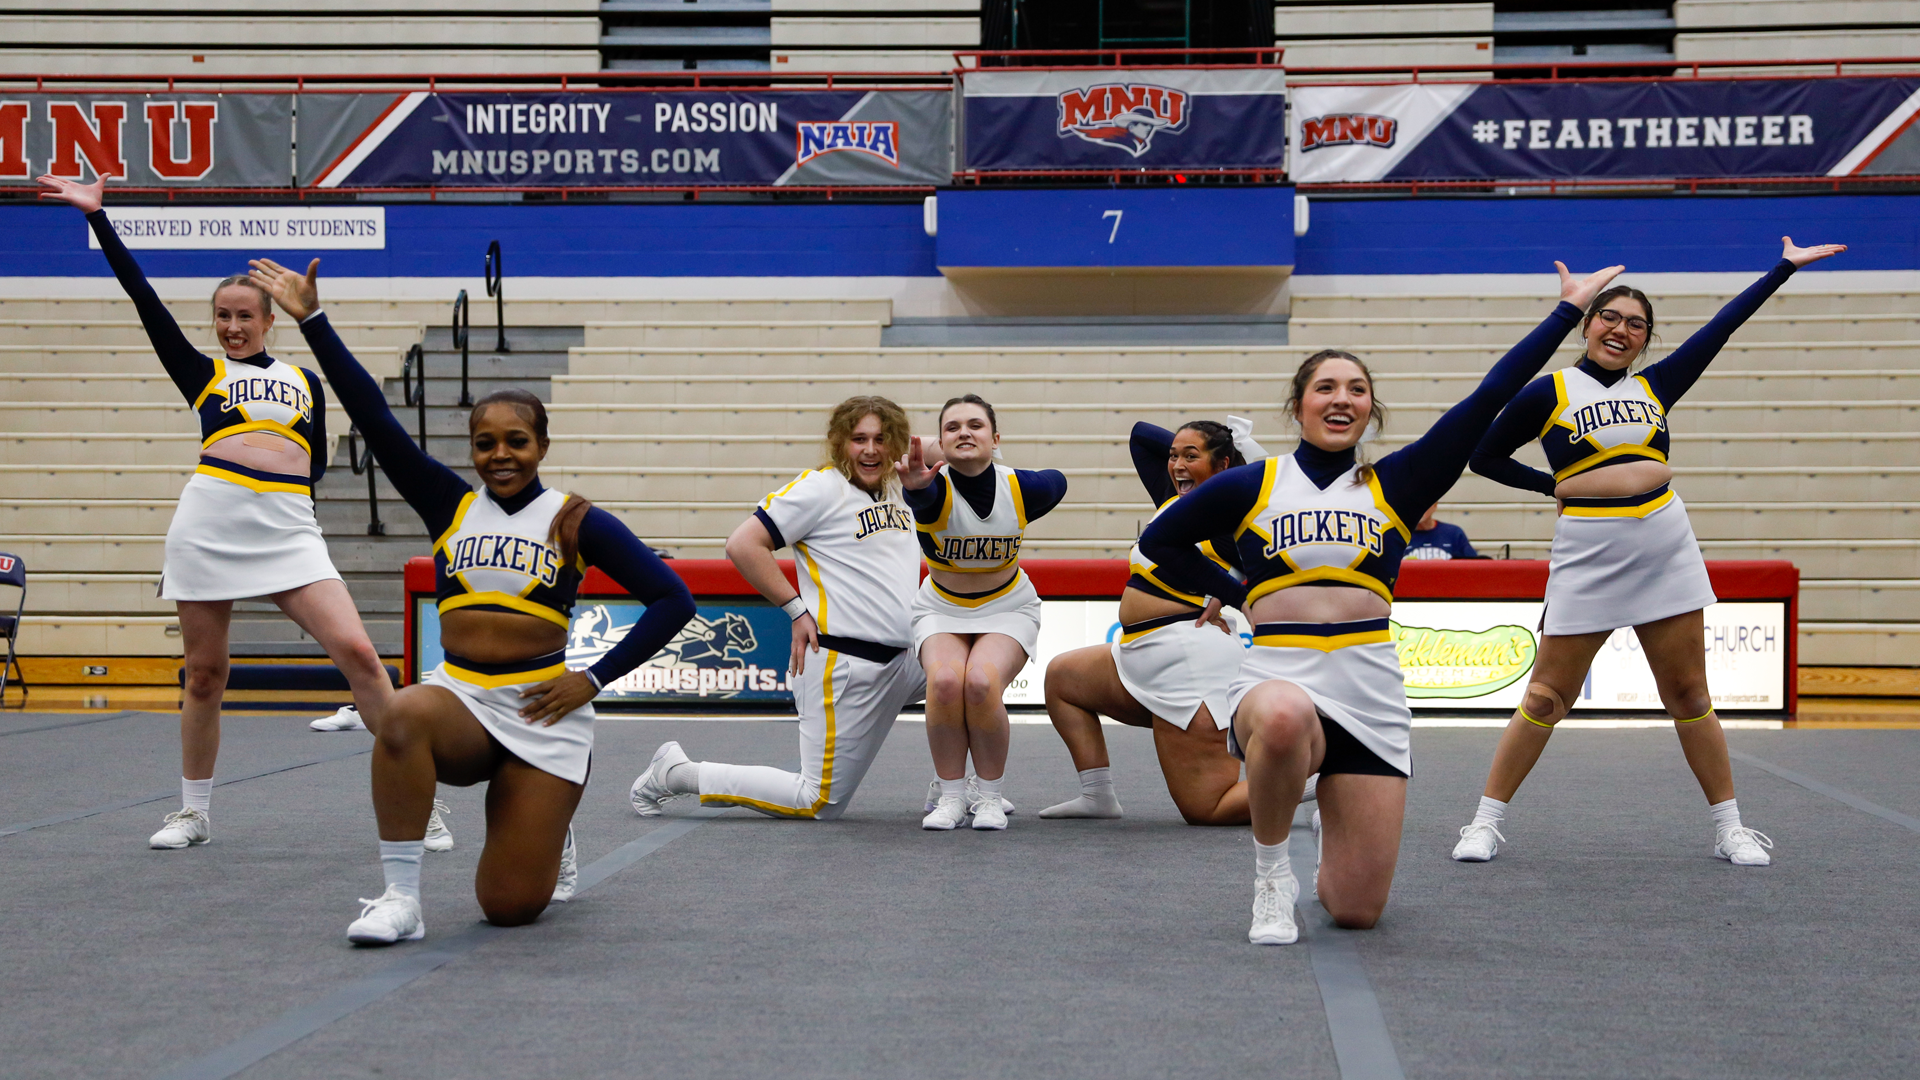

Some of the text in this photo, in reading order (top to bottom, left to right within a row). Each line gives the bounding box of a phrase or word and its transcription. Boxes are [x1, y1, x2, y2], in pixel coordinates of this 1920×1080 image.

[465, 103, 778, 134] INTEGRITY PASSION
[1059, 84, 1189, 132] MNU
[799, 122, 897, 164] NAIA
[1302, 113, 1396, 150] MNU
[1472, 114, 1815, 150] #FEARTHENEER
[432, 149, 721, 175] MNUSPORTS.COM
[112, 219, 377, 237] ESERVED FOR MNU STUDENTS
[1101, 208, 1123, 244] 7
[222, 378, 311, 423] JACKETS
[1570, 399, 1666, 444] JACKETS
[936, 535, 1022, 561] JACKETS
[1263, 508, 1383, 559] JACKETS
[446, 533, 559, 588] JACKETS
[1395, 631, 1532, 666] ickleman's
[1703, 625, 1775, 652] CHURCH
[1403, 668, 1499, 679] OURMET
